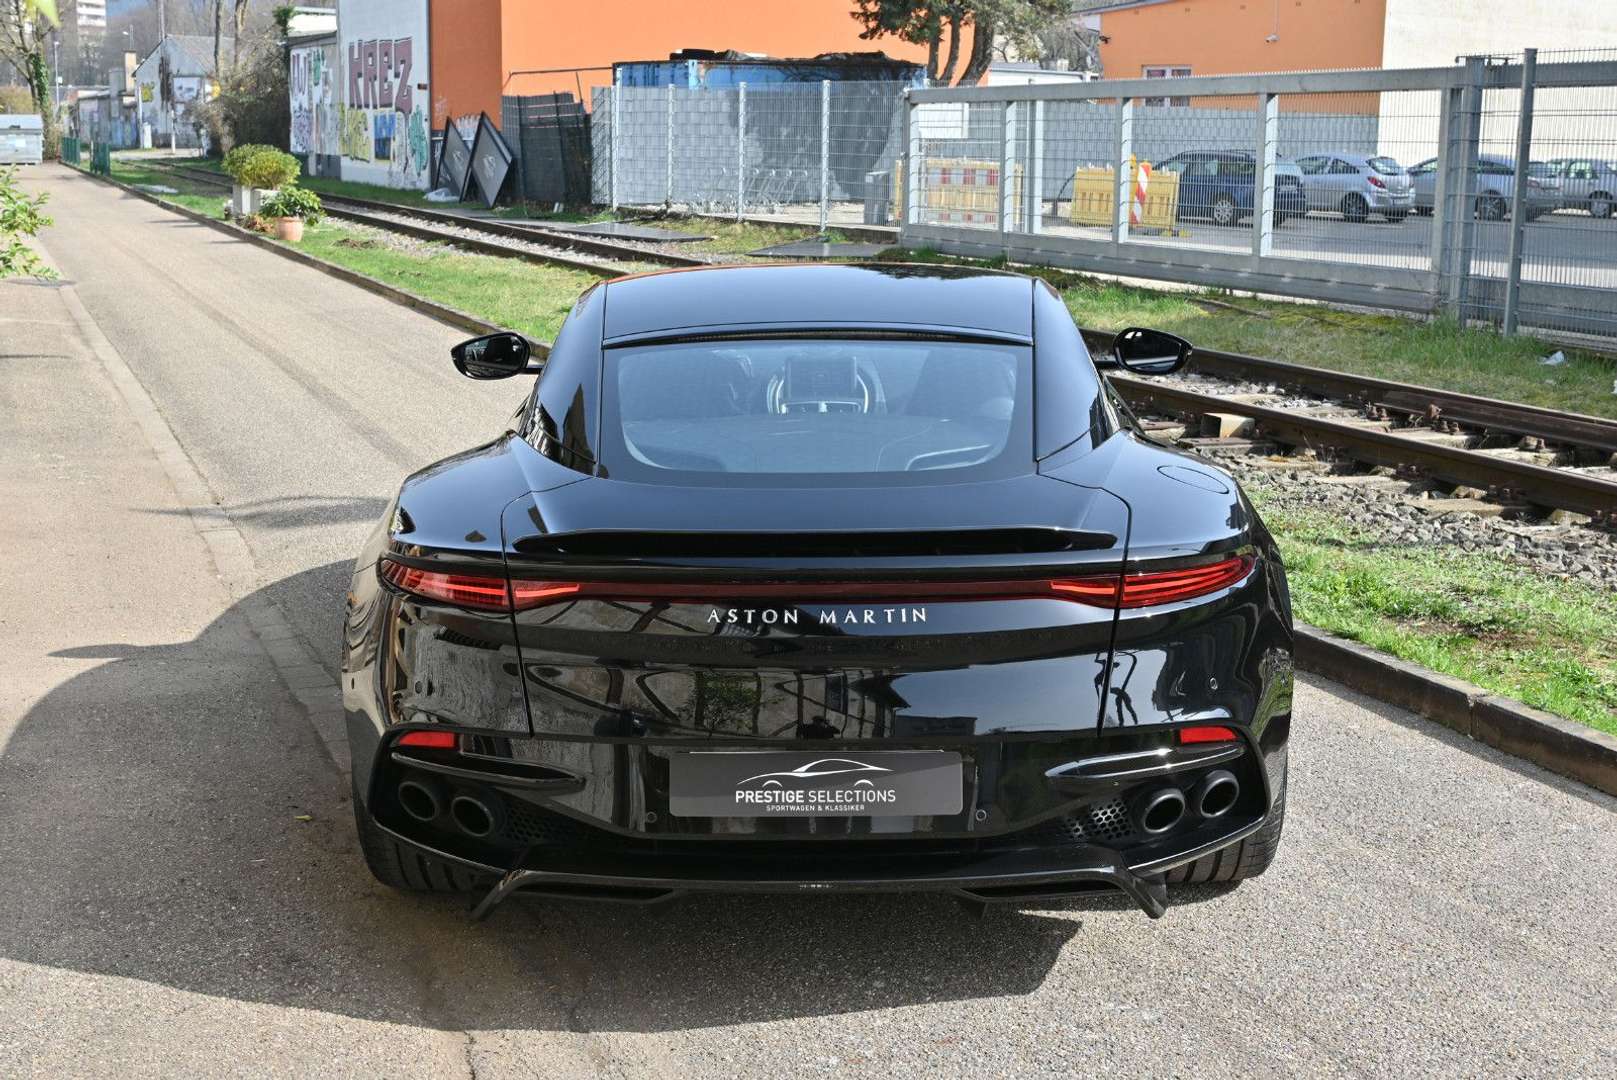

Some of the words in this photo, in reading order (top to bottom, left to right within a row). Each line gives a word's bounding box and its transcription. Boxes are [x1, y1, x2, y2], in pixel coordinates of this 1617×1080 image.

[707, 608, 798, 624] ASTON
[819, 607, 927, 624] MARTIN
[735, 790, 804, 804] PRESTIGE
[808, 789, 897, 803] SELECTIONS
[766, 804, 815, 812] SPORTWAGEN
[818, 804, 823, 812] &
[825, 804, 865, 812] KLASSIKER
